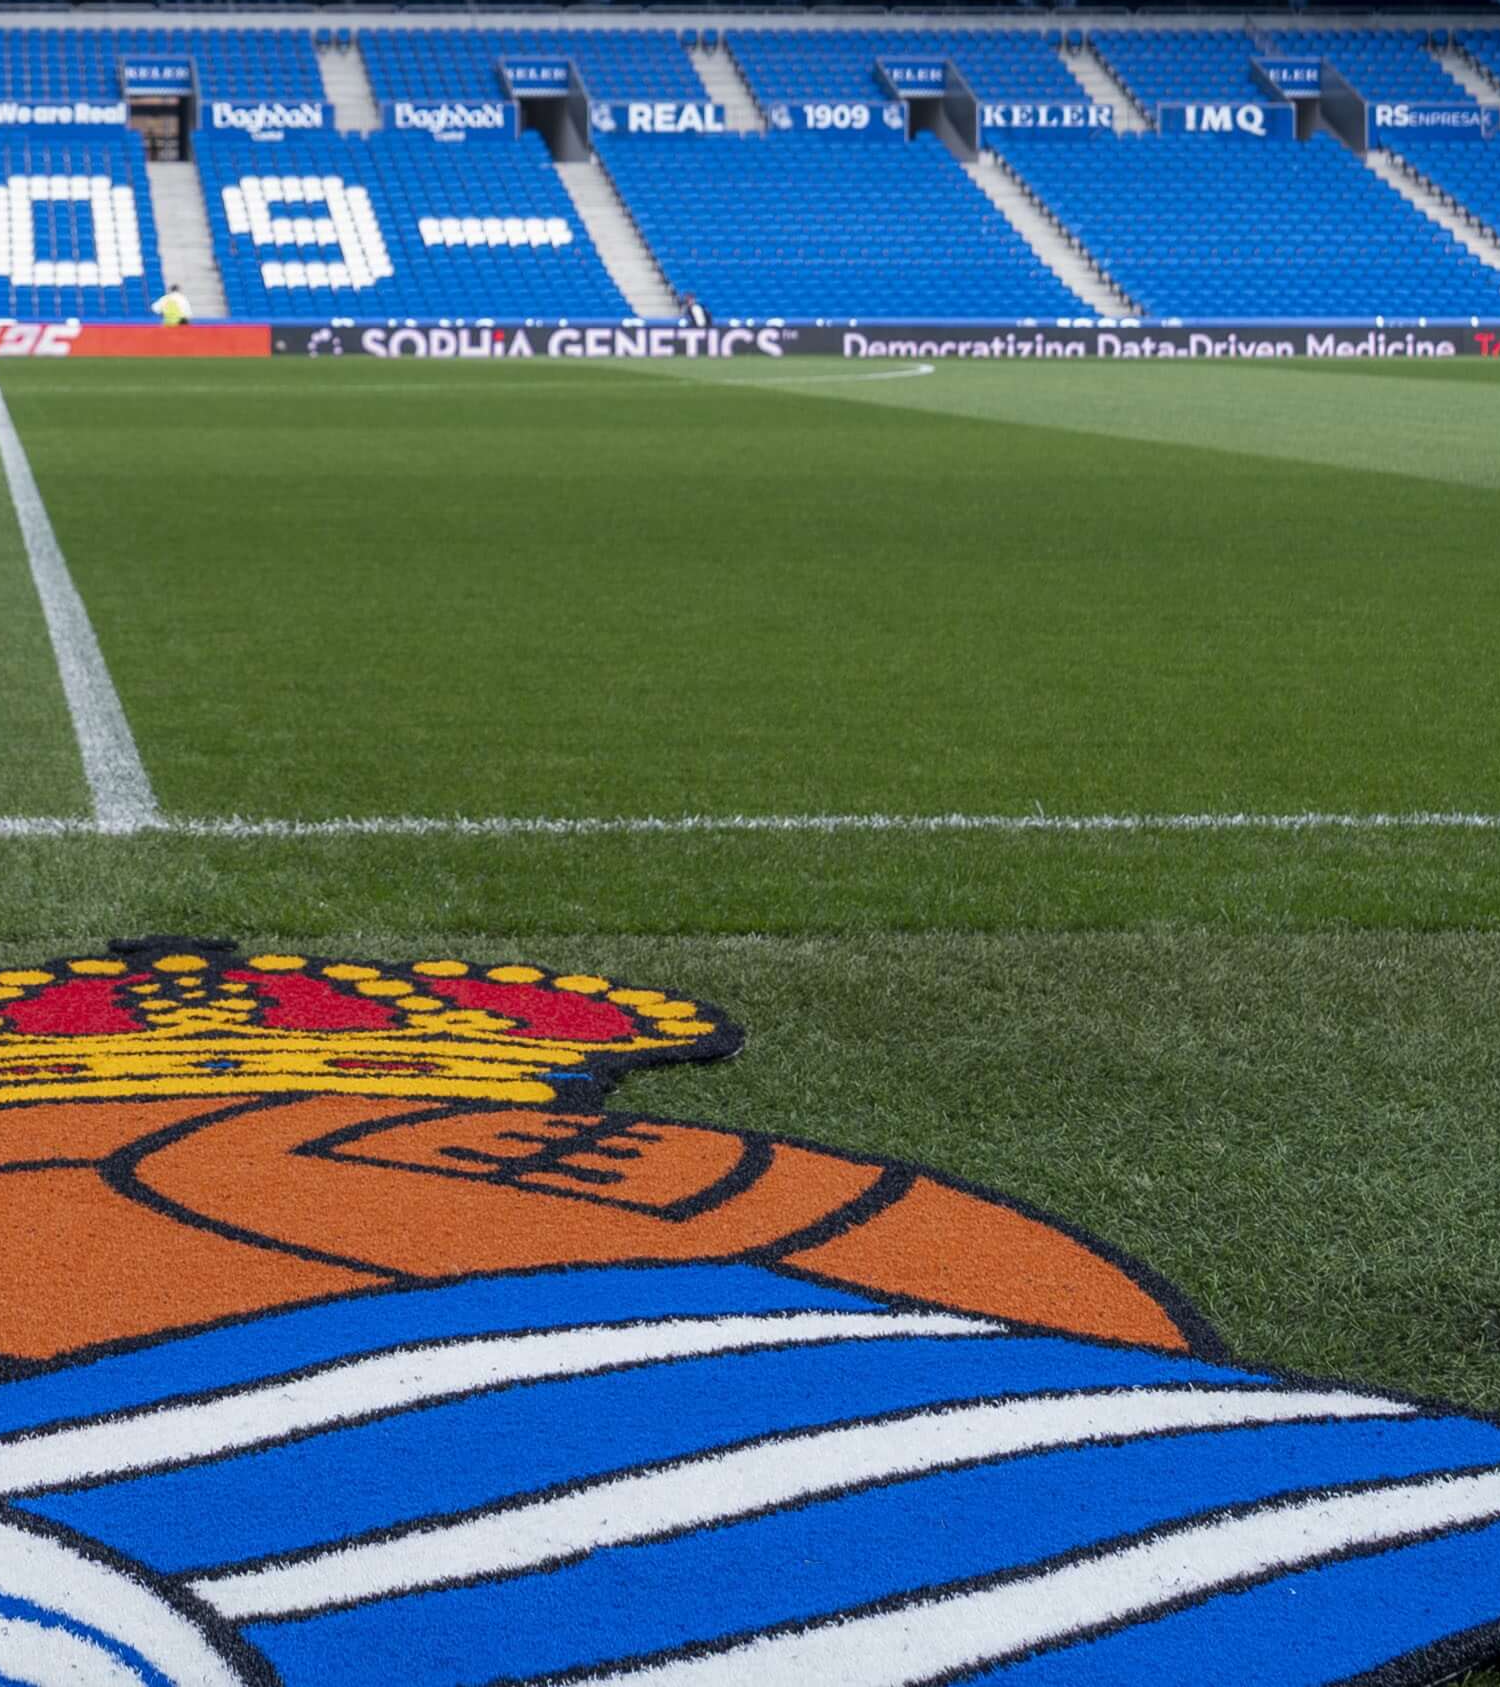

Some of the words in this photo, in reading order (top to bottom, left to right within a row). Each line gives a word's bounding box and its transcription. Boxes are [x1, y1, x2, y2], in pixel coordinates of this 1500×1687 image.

[34, 106, 73, 123] are
[76, 102, 126, 123] Real
[628, 104, 725, 132] REAL
[802, 104, 870, 129] 1909
[982, 103, 1112, 127] KELER
[1184, 104, 1267, 137] IMQ
